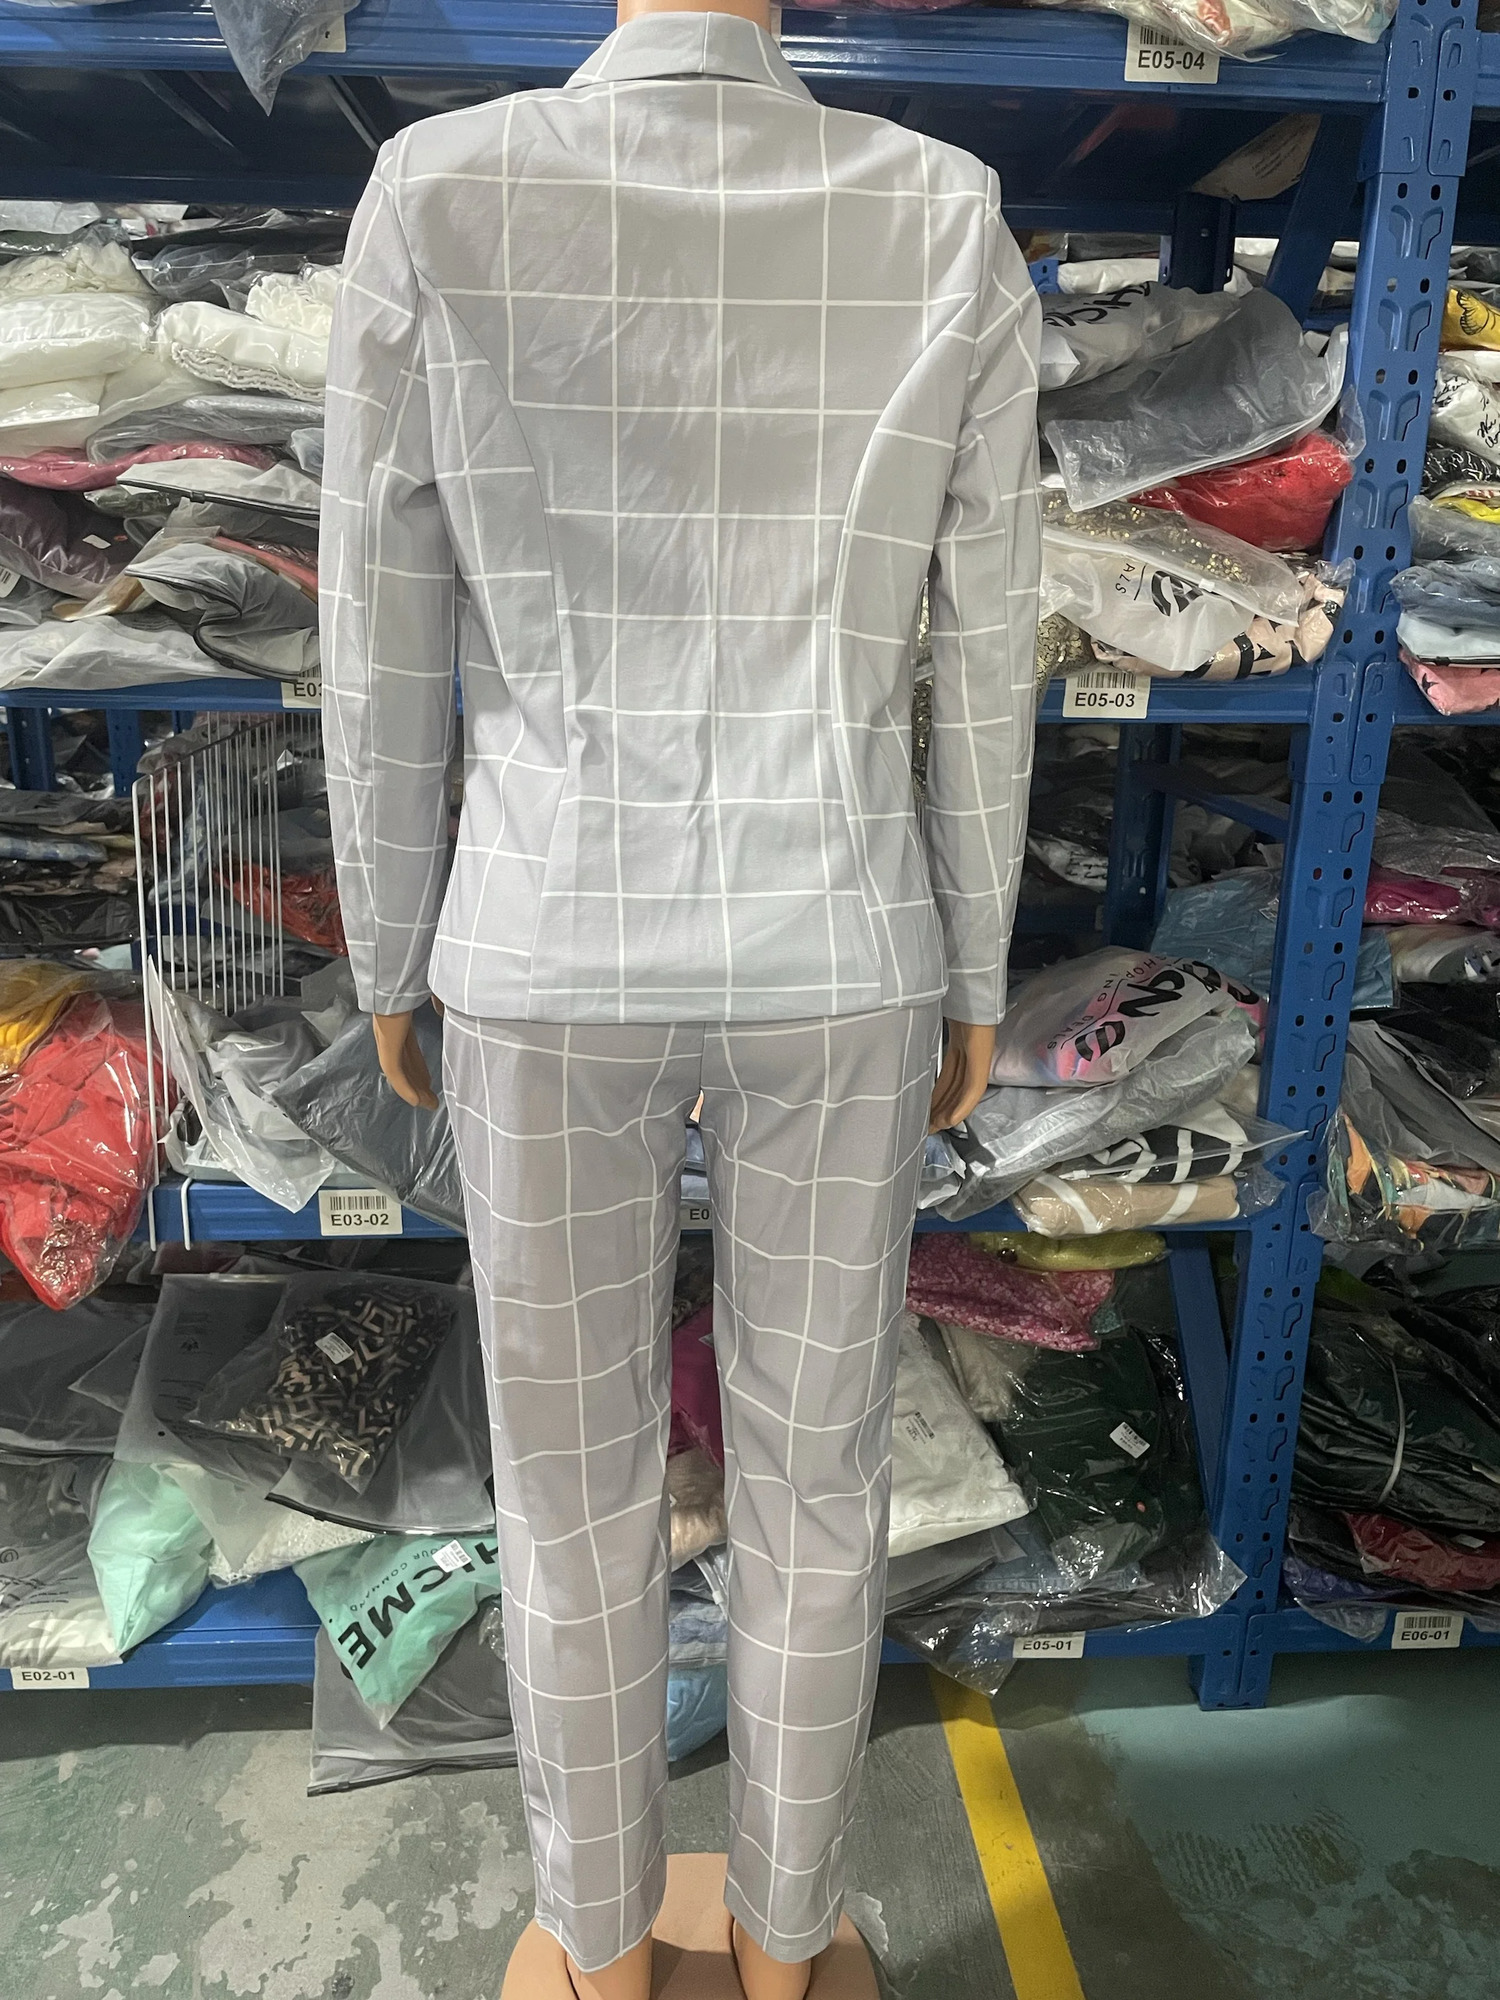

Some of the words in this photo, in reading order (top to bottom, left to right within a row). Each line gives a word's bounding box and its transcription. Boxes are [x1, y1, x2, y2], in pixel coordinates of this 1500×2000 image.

[1137, 49, 1205, 70] E05-04
[293, 682, 322, 697] E0
[1074, 692, 1135, 707] E05-03
[1046, 1014, 1094, 1050] DEALS
[330, 1213, 389, 1226] E03-02
[337, 1541, 498, 1670] HCME
[1400, 1630, 1450, 1641] E06-01
[1022, 1640, 1073, 1651] E05-01
[21, 1671, 76, 1681] E02-01
